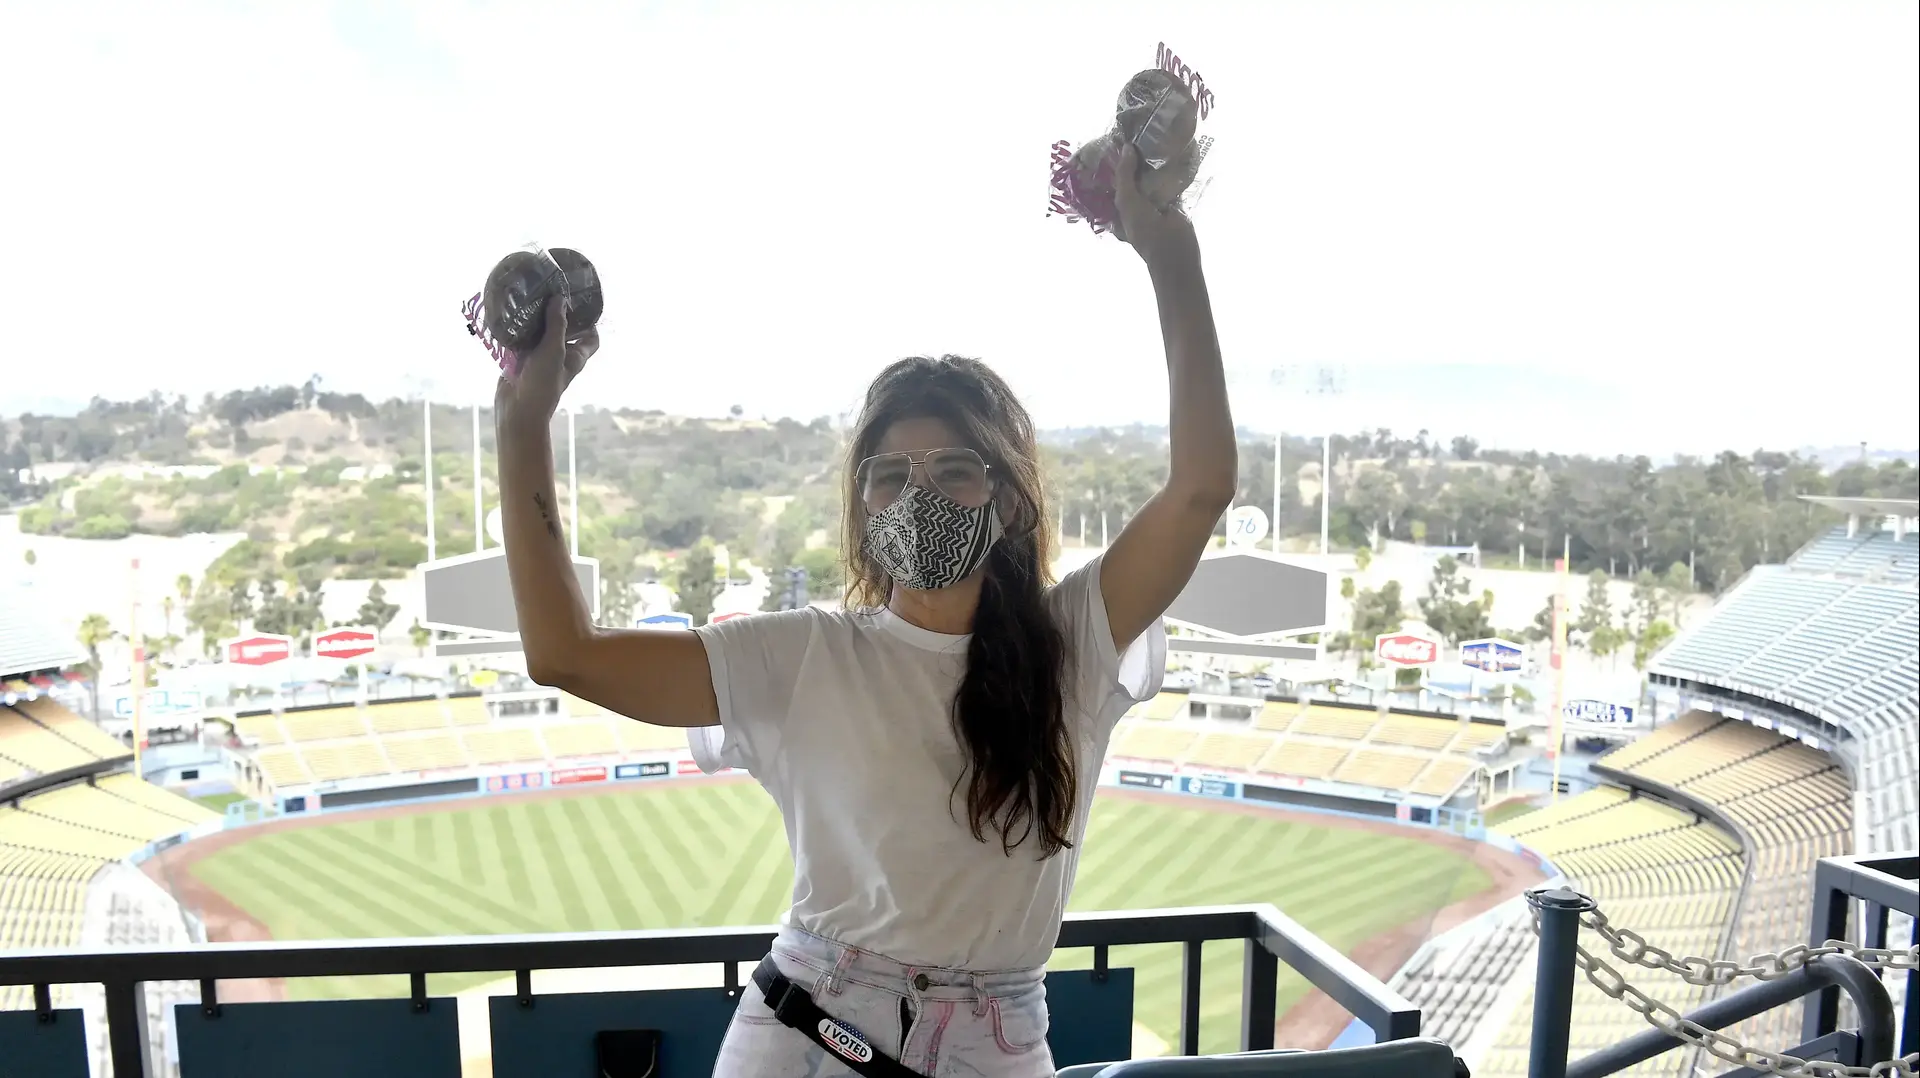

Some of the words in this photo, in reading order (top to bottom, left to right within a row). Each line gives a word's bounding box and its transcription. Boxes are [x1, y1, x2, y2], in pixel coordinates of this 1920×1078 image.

[1236, 516, 1256, 534] 76
[824, 1024, 831, 1034] I
[832, 1028, 868, 1058] VOTED
